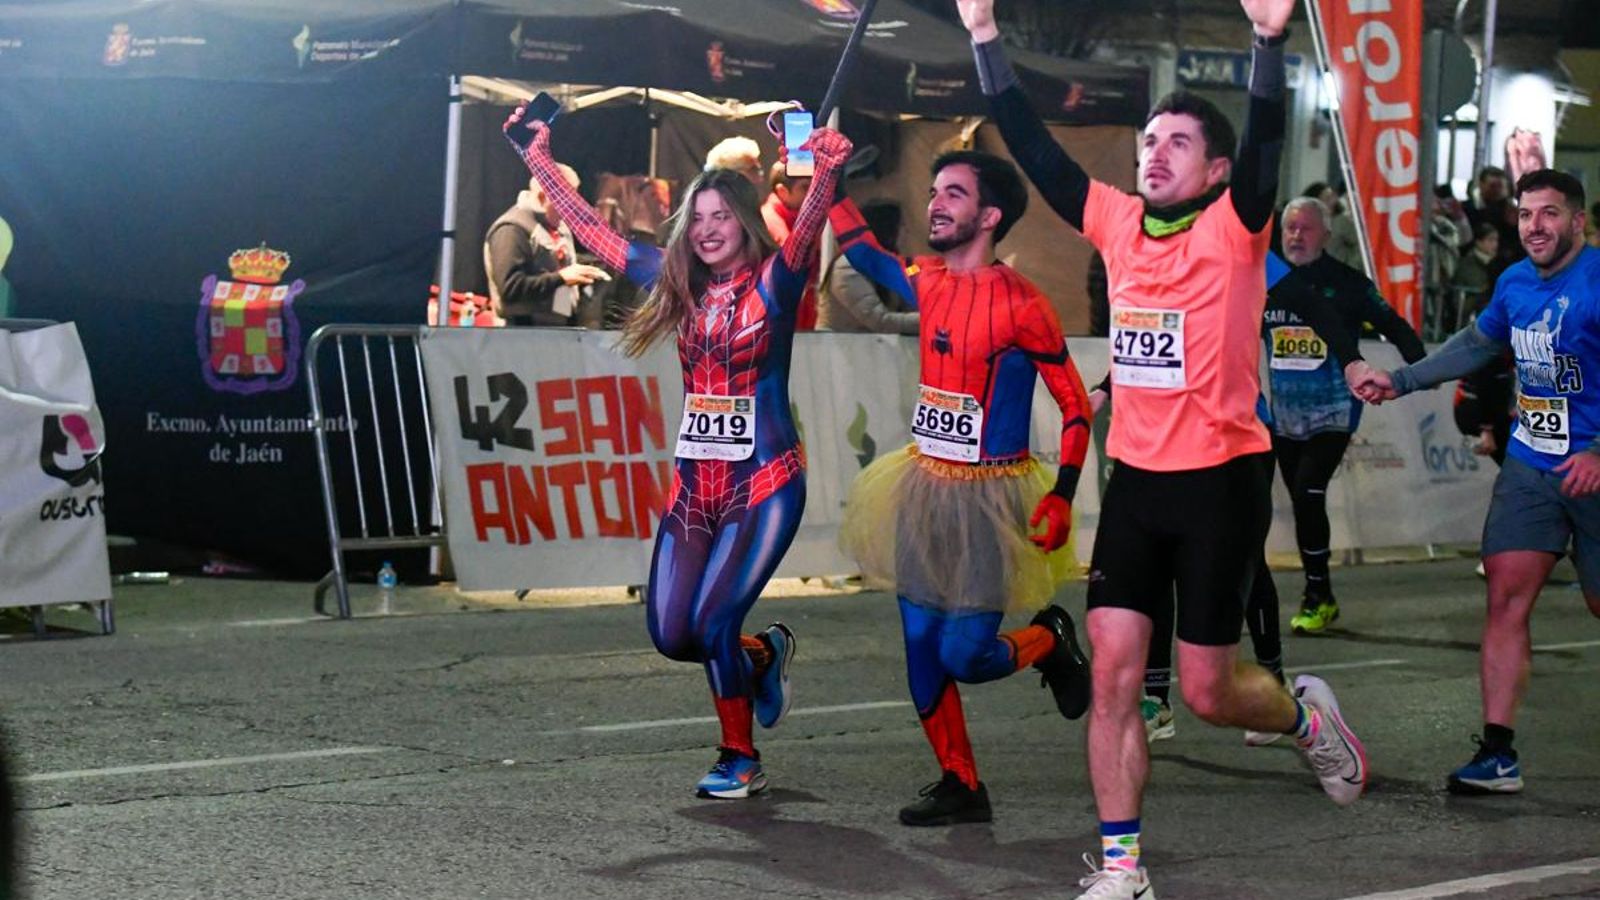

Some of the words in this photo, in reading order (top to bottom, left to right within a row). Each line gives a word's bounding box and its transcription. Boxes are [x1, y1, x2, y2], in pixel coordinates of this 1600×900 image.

[1114, 329, 1175, 358] 4792
[1276, 338, 1322, 354] 4060
[1553, 354, 1583, 393] 25
[146, 412, 211, 433] Excmo.
[454, 372, 535, 451] 42
[536, 375, 667, 457] SAN
[687, 412, 747, 437] 7019
[916, 404, 974, 437] 5696
[209, 442, 231, 463] de
[235, 442, 283, 464] Jaén
